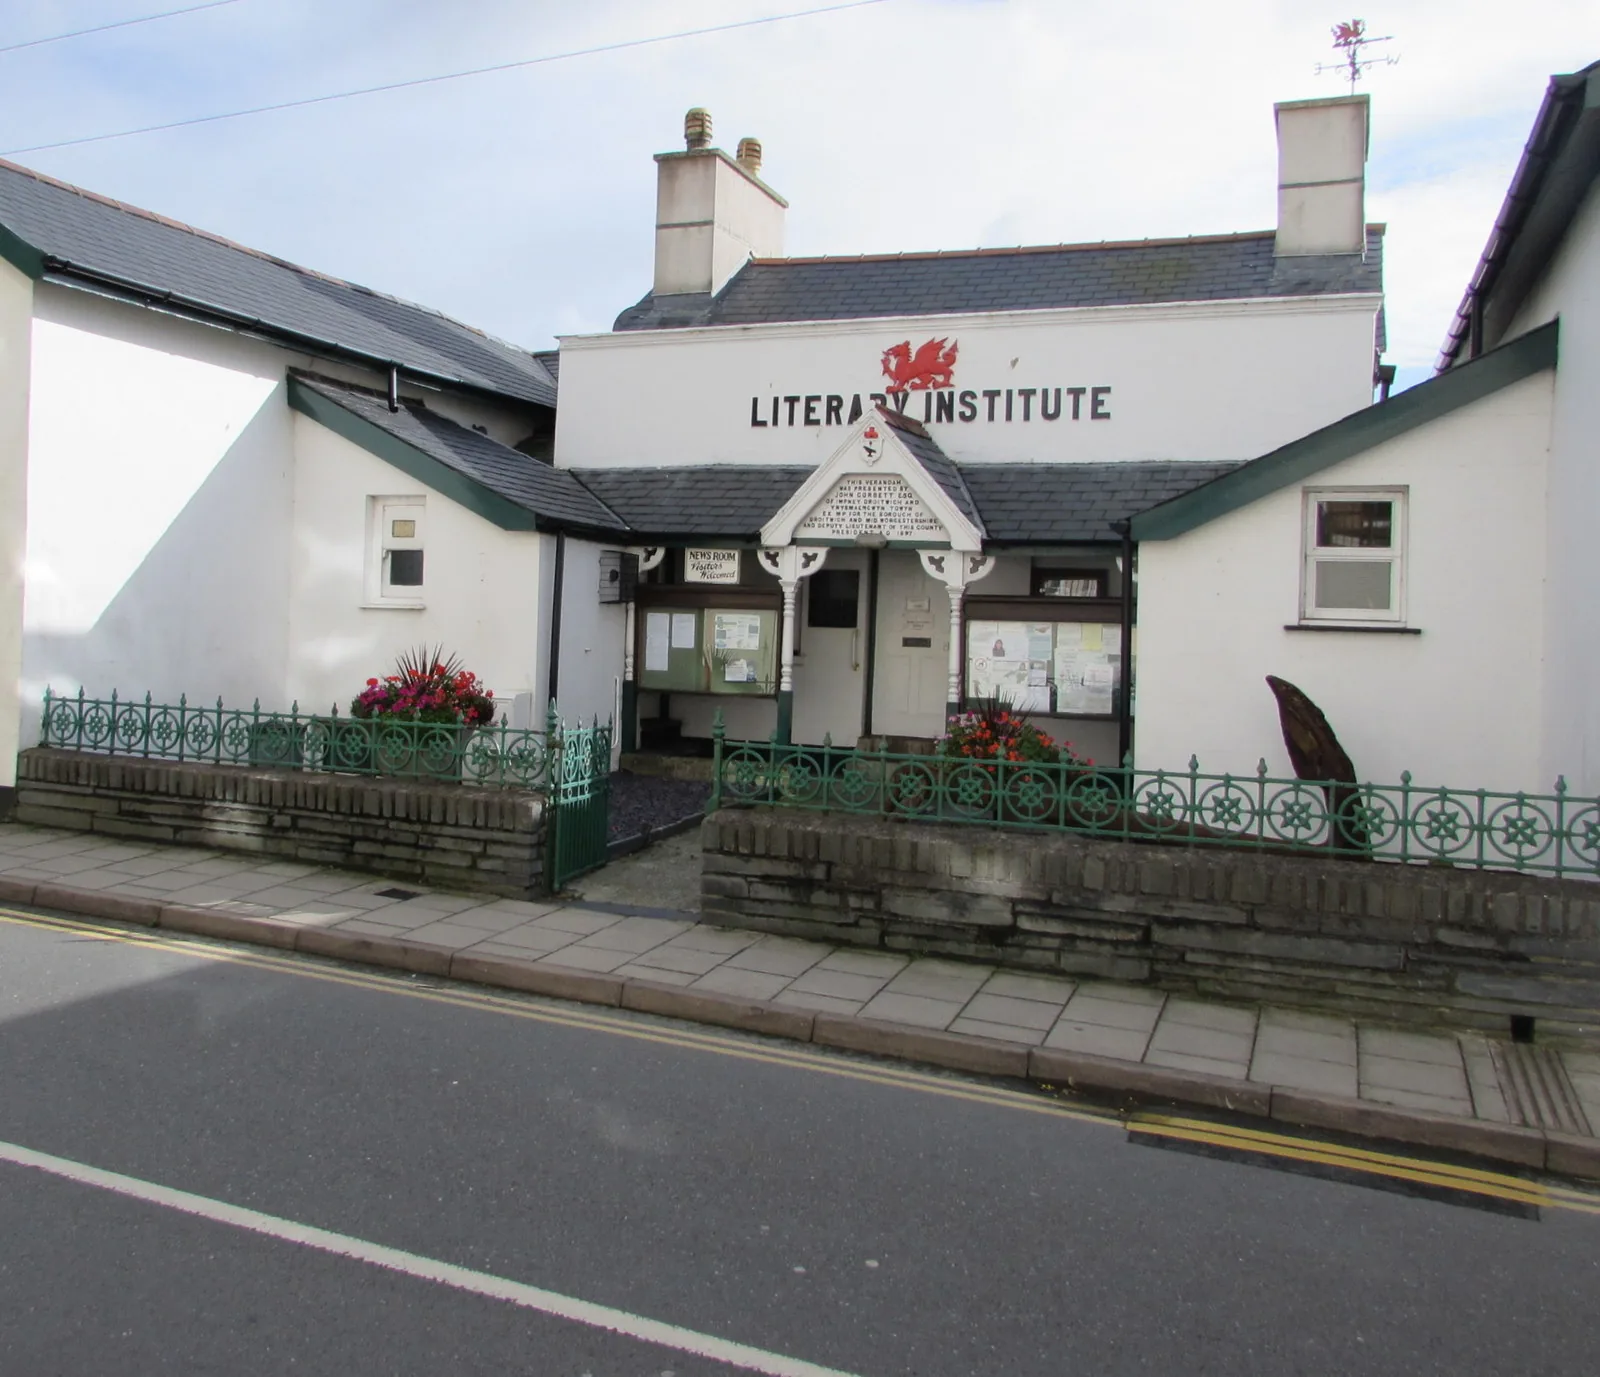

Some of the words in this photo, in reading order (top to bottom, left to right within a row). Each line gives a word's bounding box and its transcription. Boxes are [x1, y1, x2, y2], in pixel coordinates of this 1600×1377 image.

[924, 386, 1112, 424] INSTITUTE
[689, 551, 711, 560] NEWS
[713, 552, 735, 561] ROOM
[690, 561, 722, 571] Visitors
